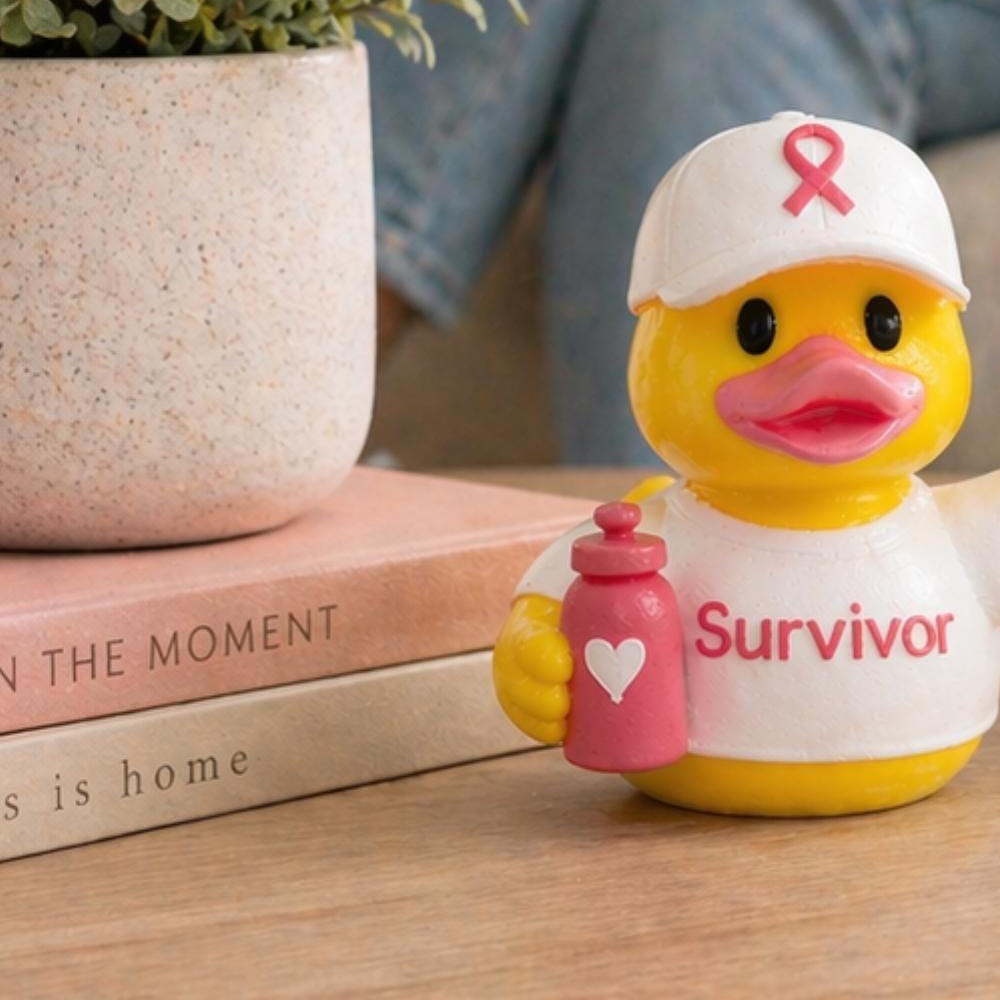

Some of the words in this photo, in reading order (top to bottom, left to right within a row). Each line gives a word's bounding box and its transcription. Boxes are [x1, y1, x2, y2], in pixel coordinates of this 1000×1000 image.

[42, 638, 125, 687] THE
[149, 604, 338, 671] MOMENT
[695, 600, 954, 661] Survivor
[54, 773, 90, 811] is
[121, 750, 249, 798] home
